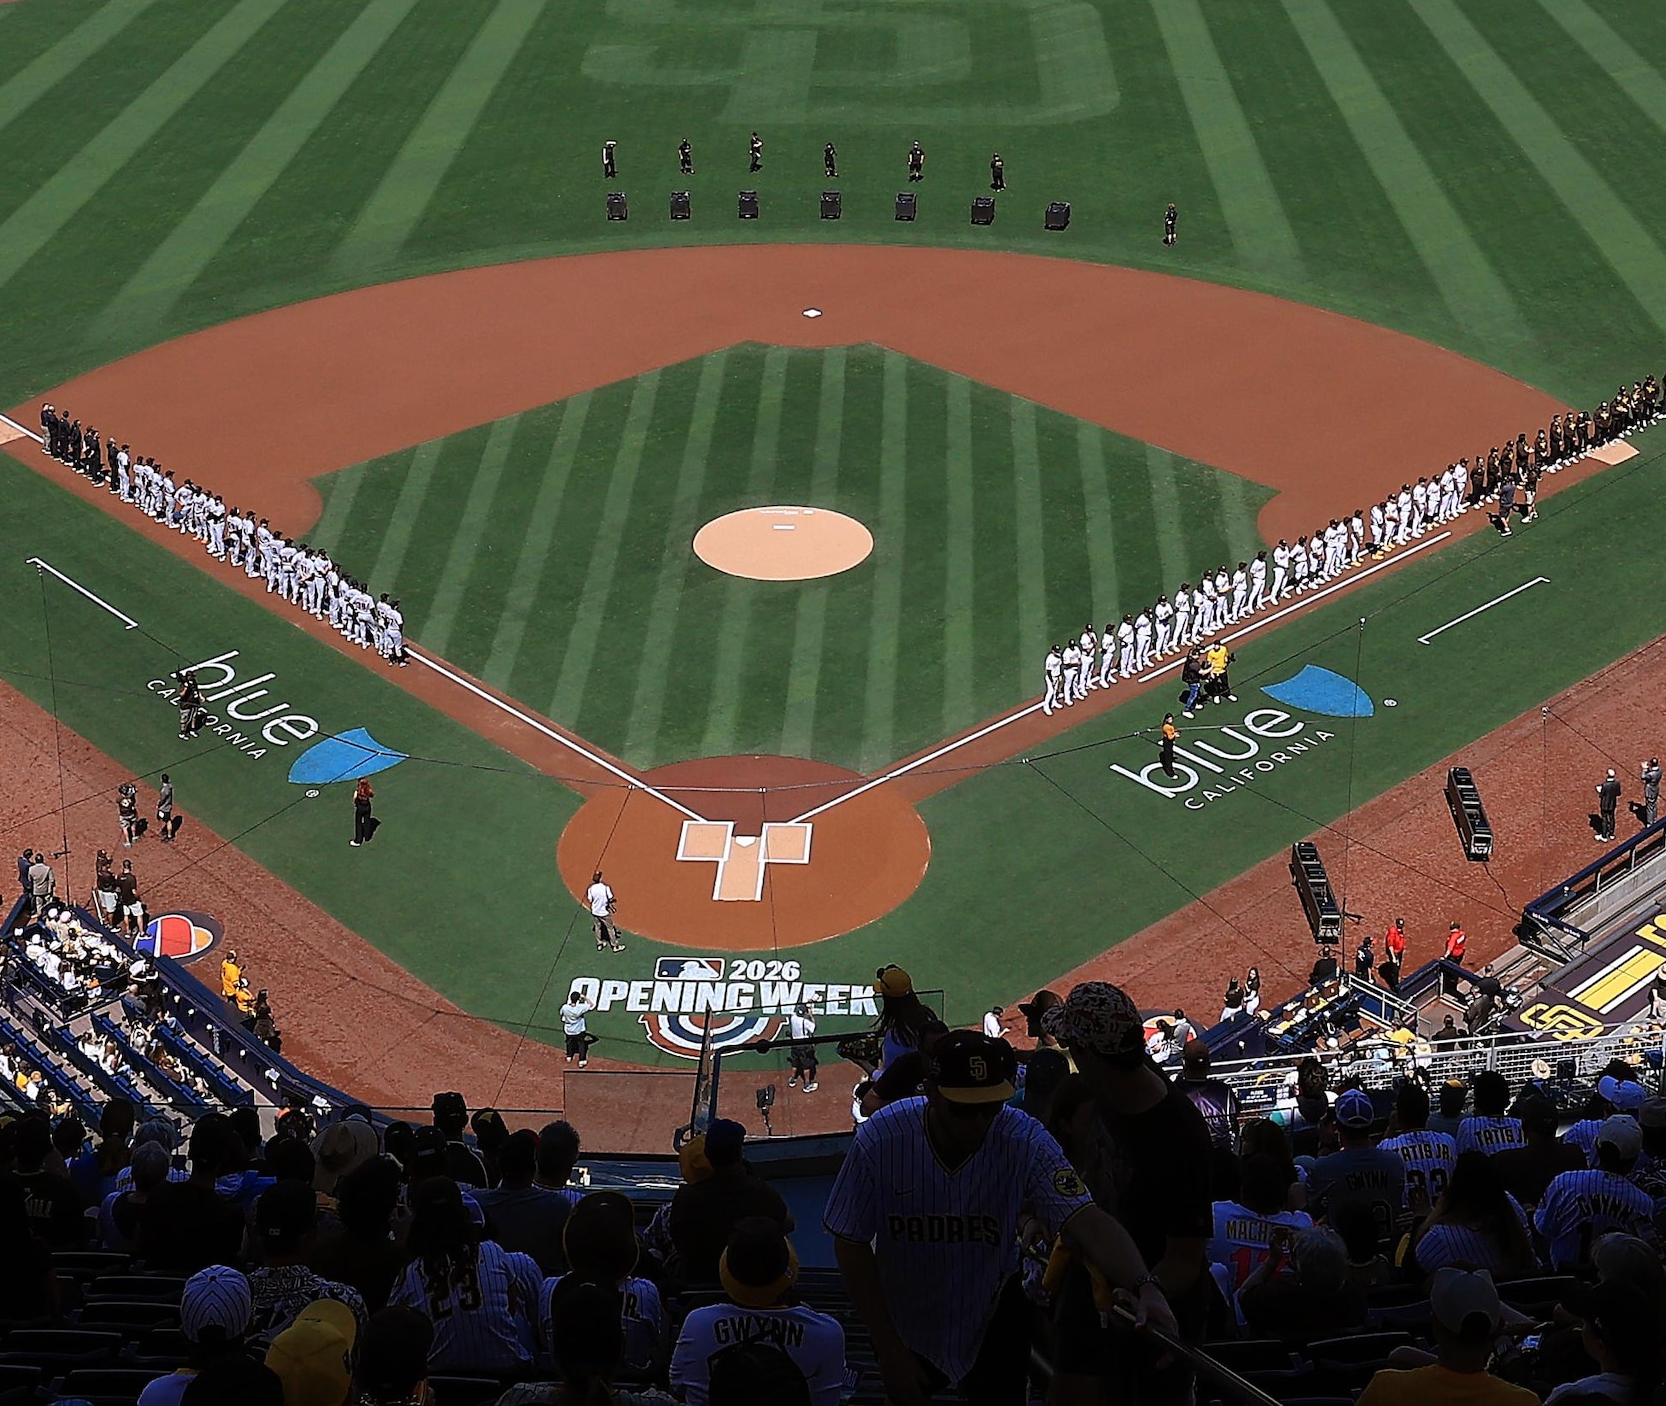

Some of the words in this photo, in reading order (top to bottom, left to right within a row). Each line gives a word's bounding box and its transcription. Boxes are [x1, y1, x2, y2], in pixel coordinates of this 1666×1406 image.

[178, 650, 320, 746] blue
[1110, 707, 1306, 800] blue
[1184, 728, 1337, 812] CALIFORNIA
[729, 960, 801, 982] 2026
[568, 977, 755, 1013] OPENING
[762, 981, 880, 1017] WEEK
[888, 1214, 1002, 1248] PADRES
[713, 1316, 806, 1350] GWYNN
